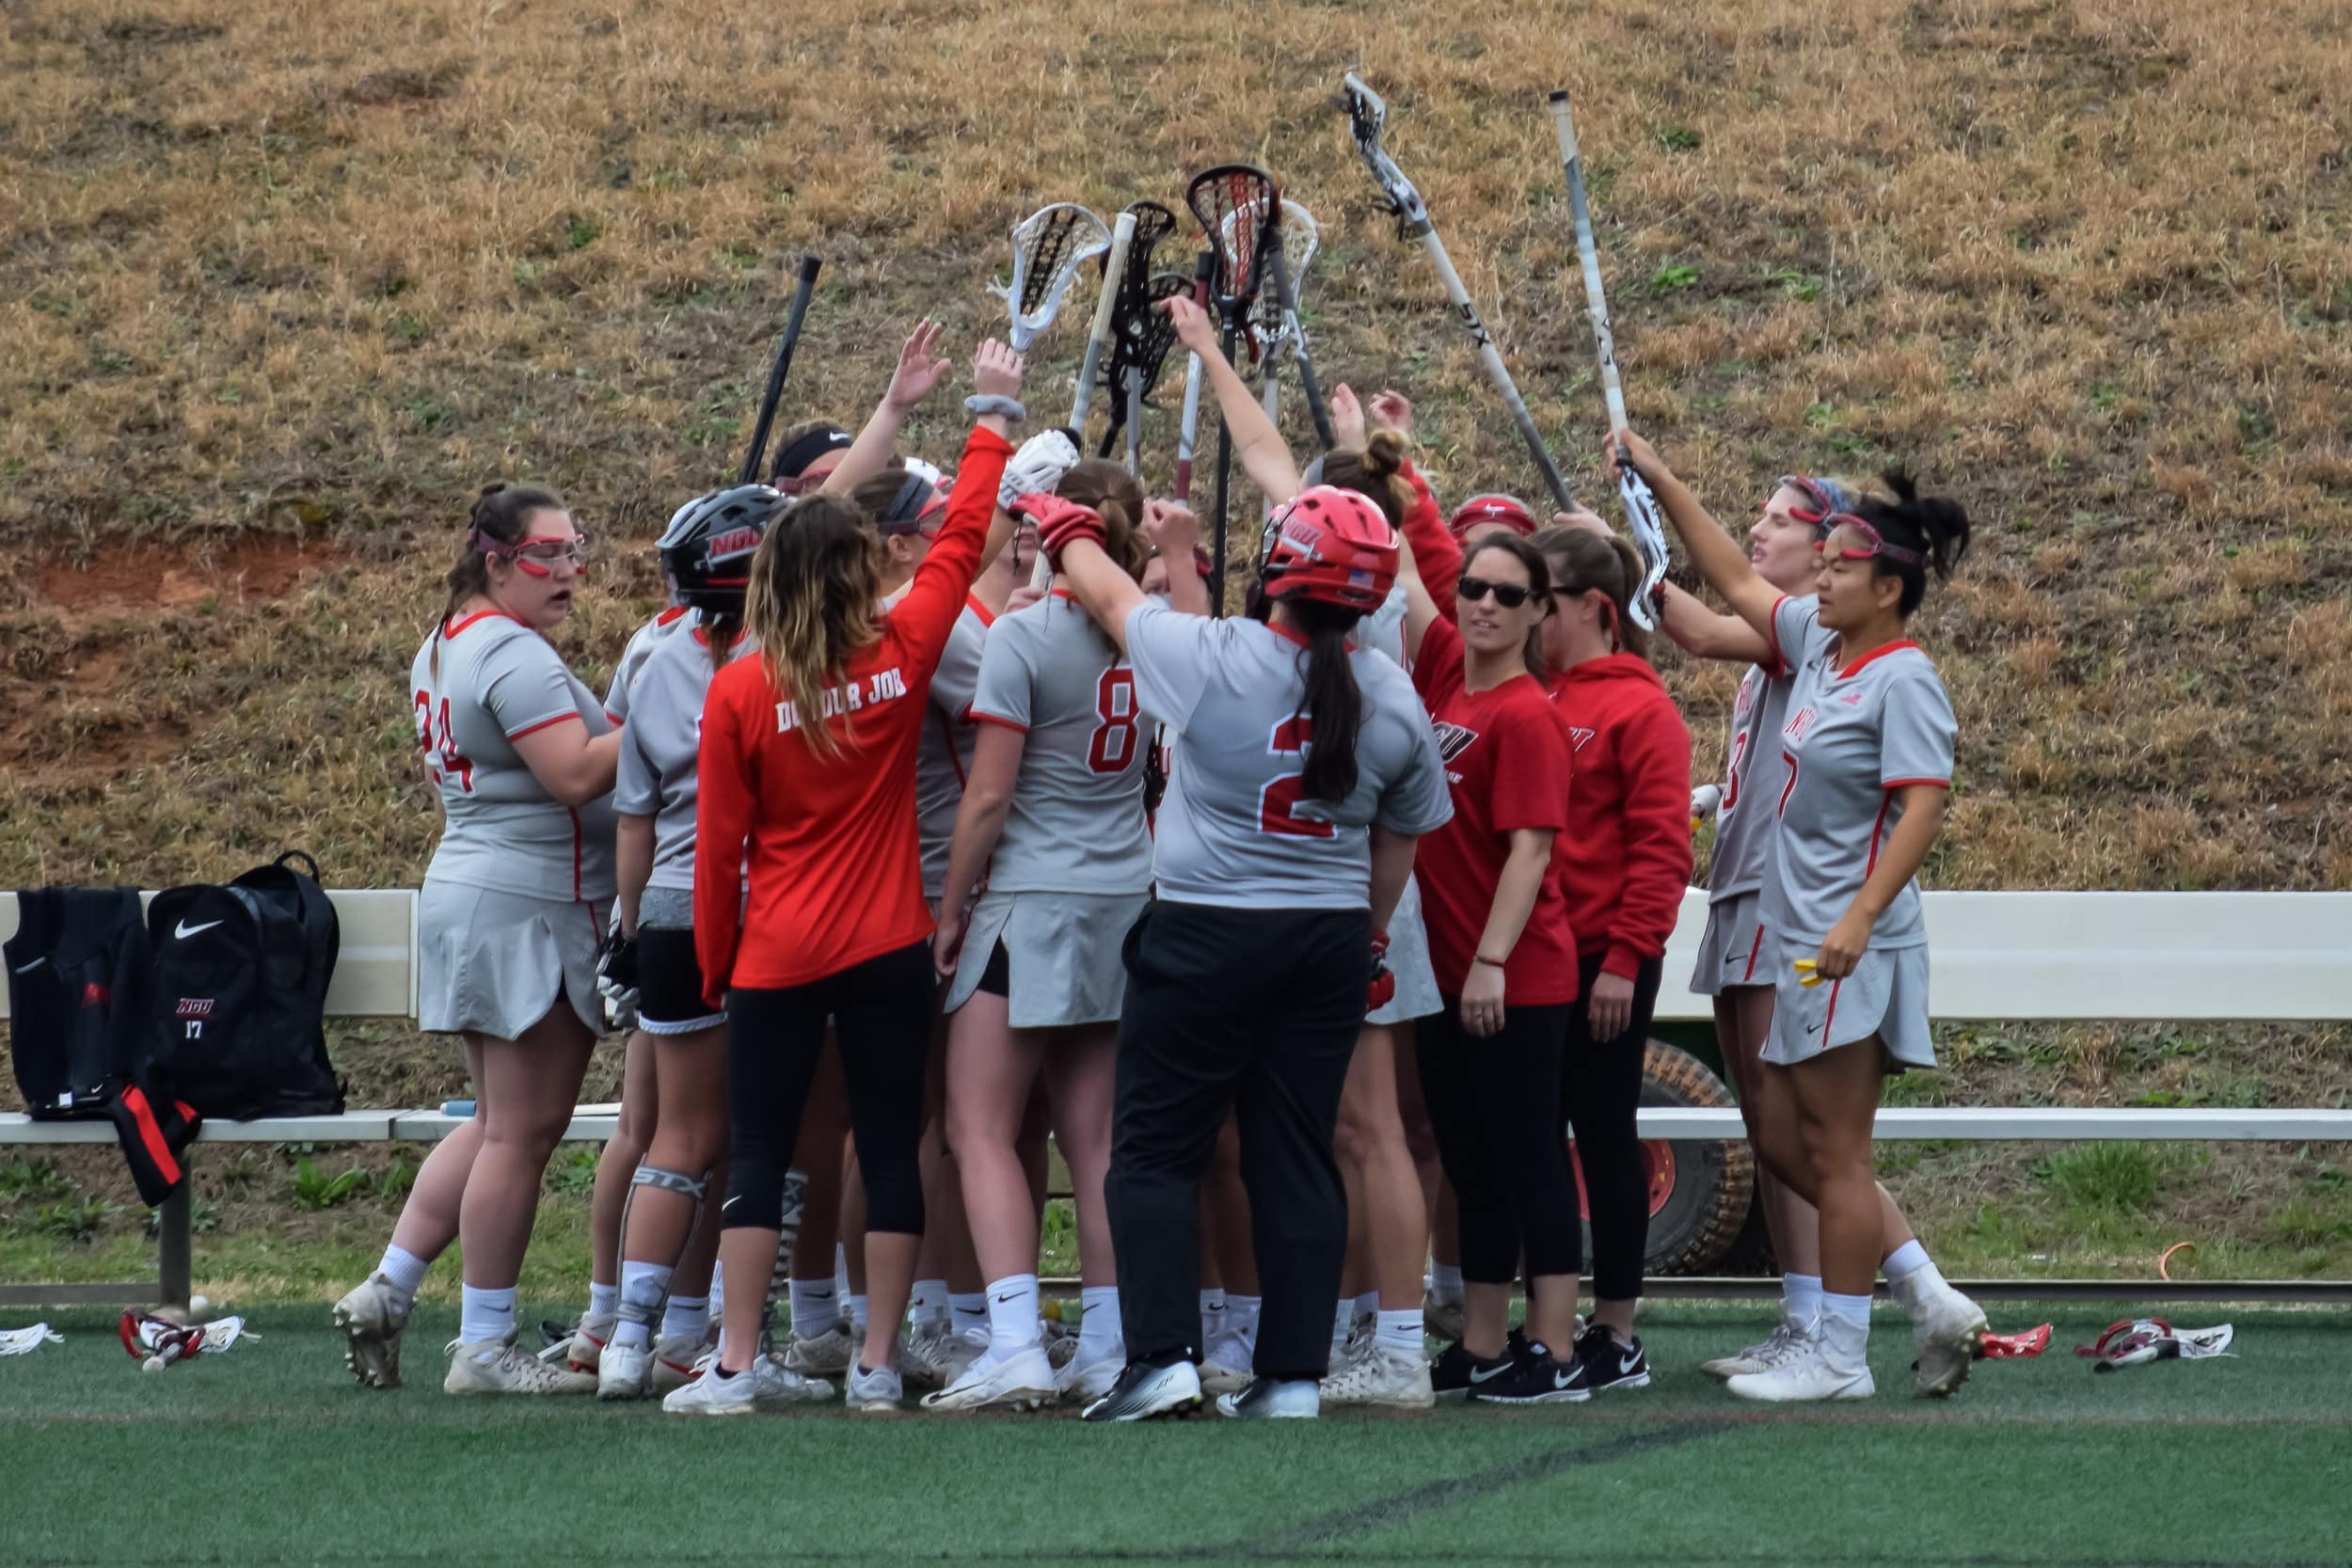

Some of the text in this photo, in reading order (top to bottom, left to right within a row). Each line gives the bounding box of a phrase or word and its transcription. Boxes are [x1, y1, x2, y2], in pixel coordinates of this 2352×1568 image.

[811, 682, 863, 722] OUR
[868, 667, 908, 705] JOB
[413, 687, 475, 796] 24
[1086, 667, 1140, 774] 8
[175, 997, 215, 1018] NGU
[185, 1020, 202, 1039] 17
[630, 1166, 707, 1200] STX
